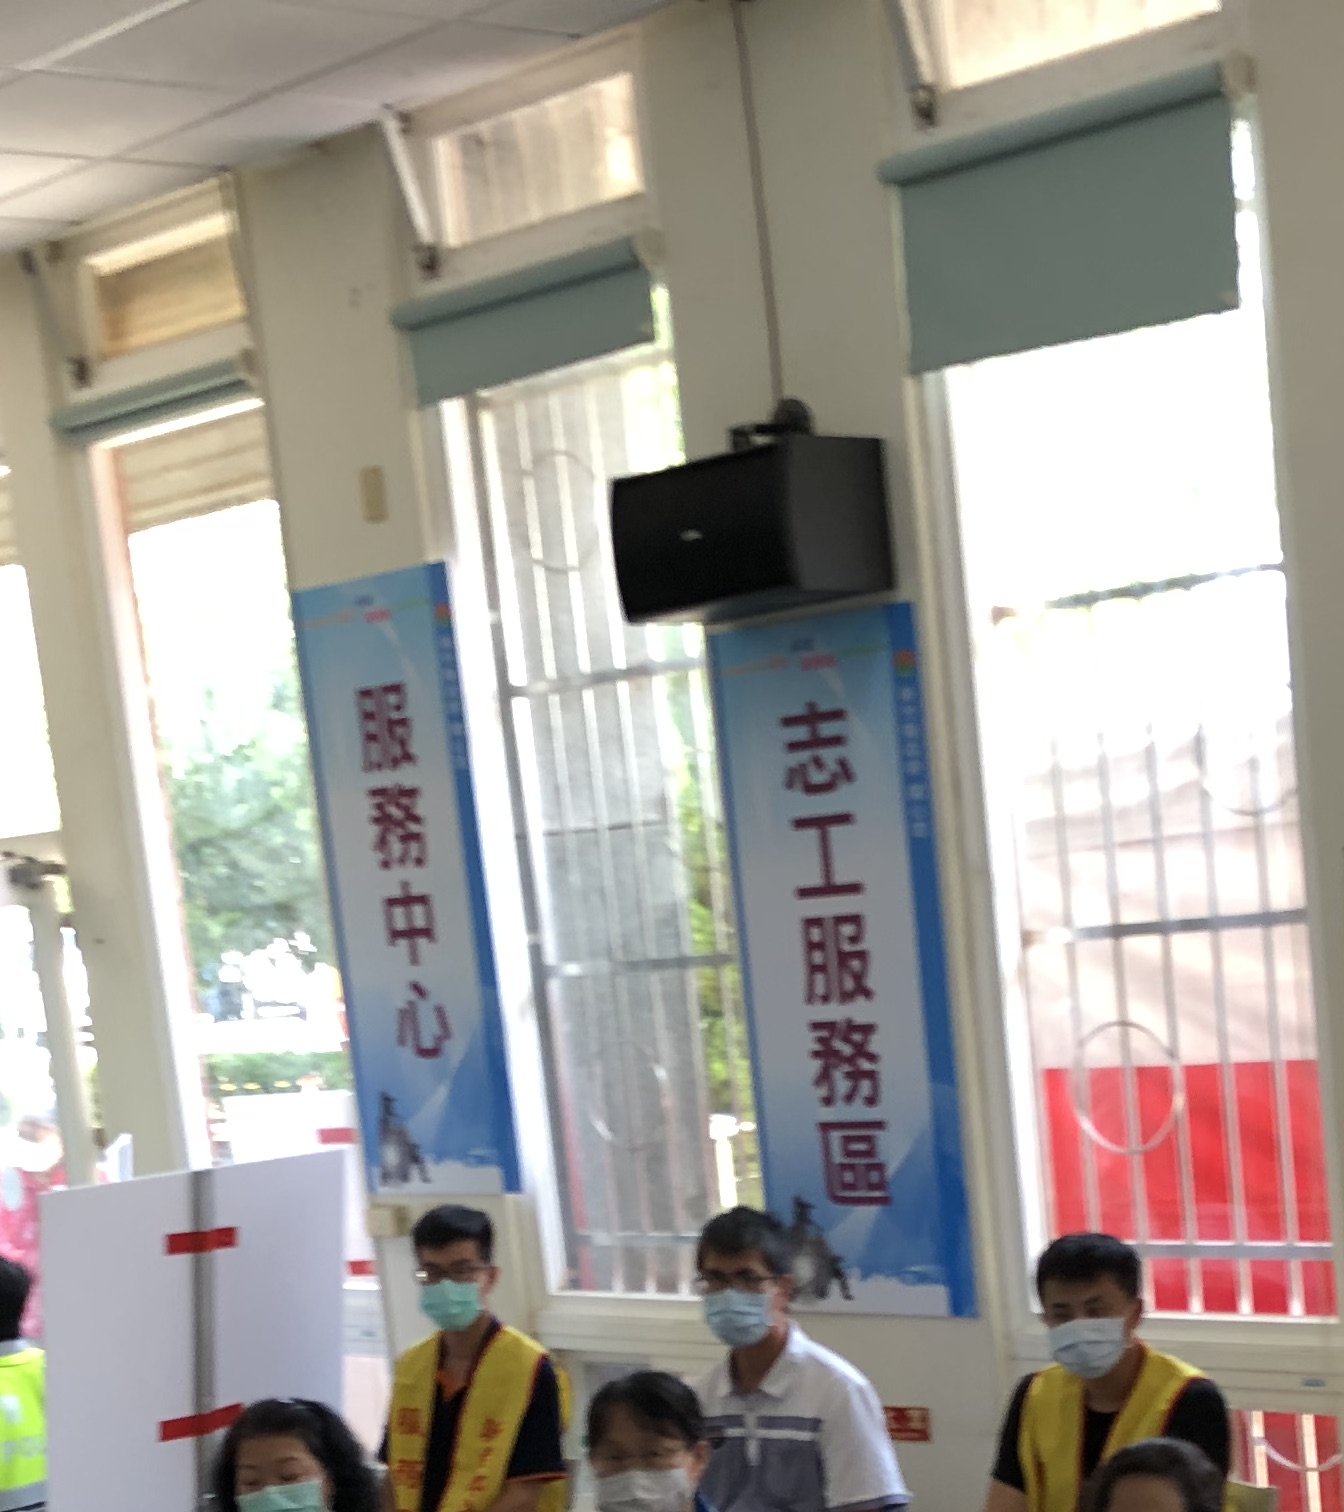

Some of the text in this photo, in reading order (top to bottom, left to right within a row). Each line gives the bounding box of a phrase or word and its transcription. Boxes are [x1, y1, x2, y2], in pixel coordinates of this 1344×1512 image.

[356, 681, 452, 1061] 服務中心
[778, 700, 892, 1207] 志工服務區
